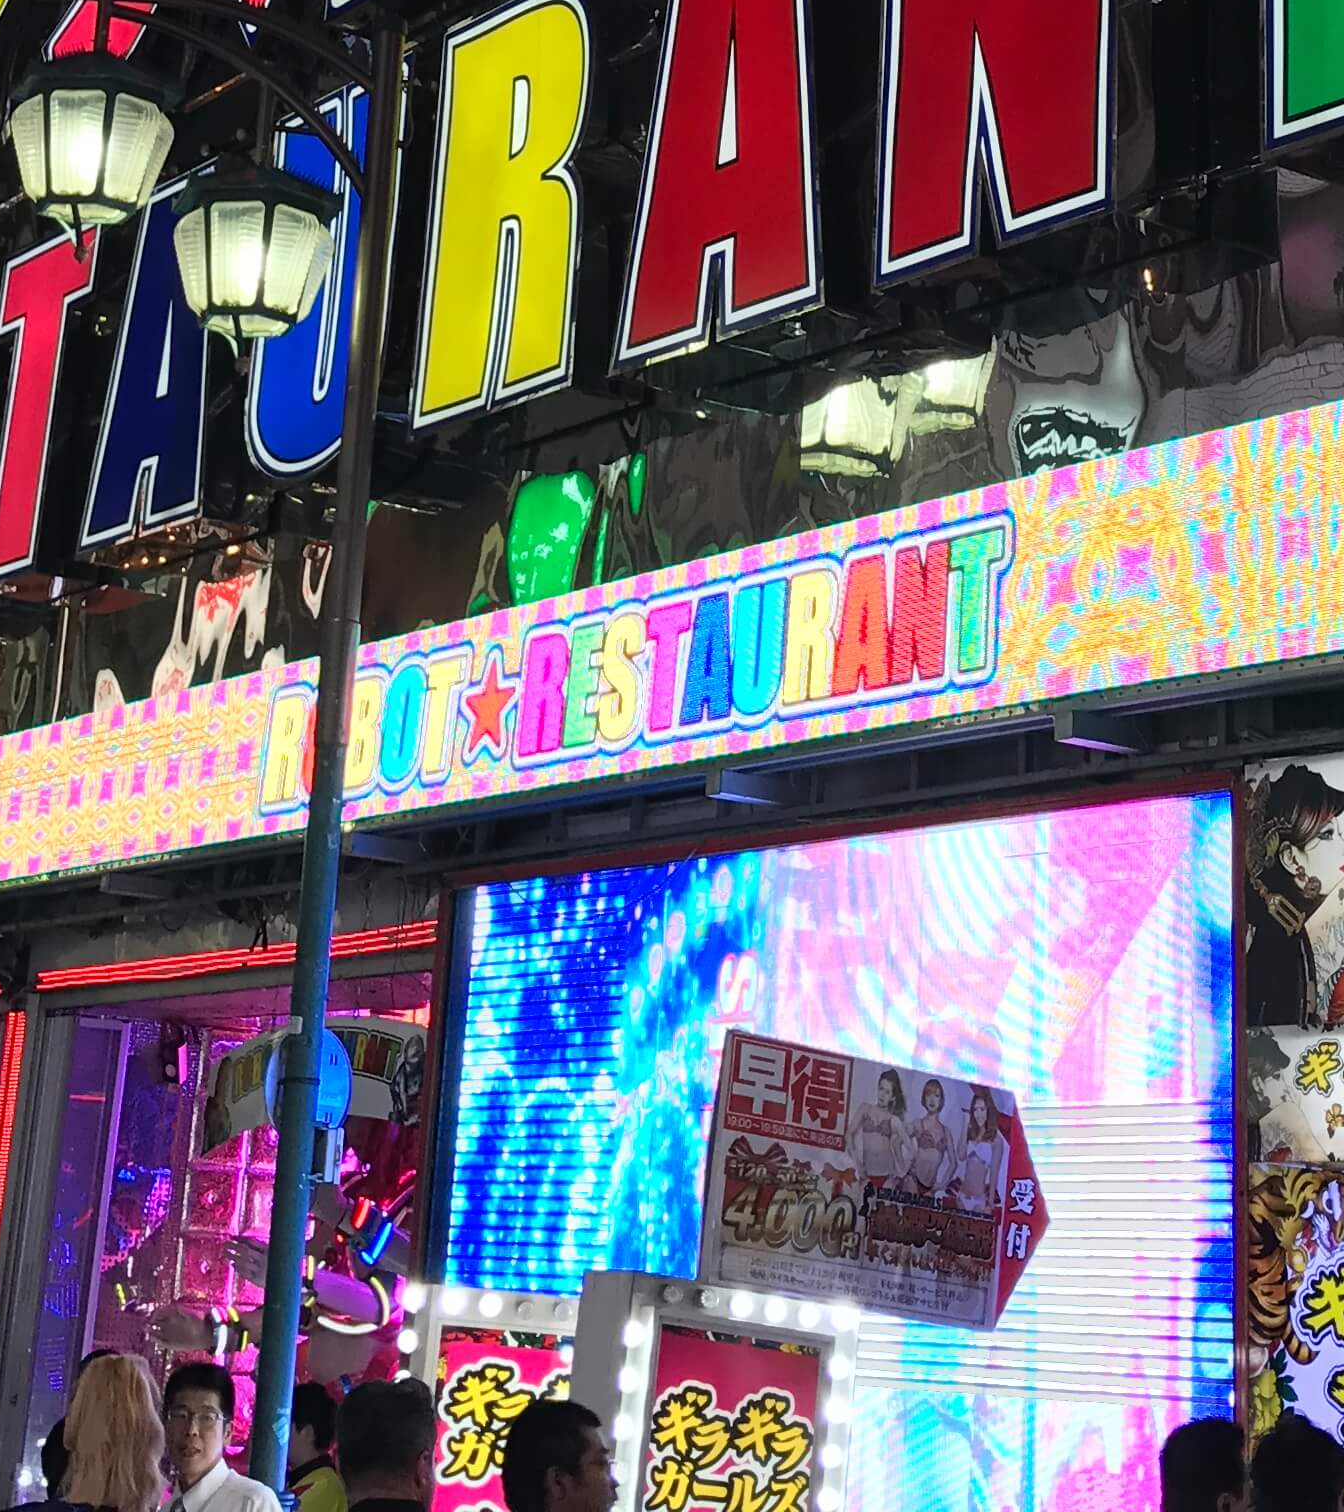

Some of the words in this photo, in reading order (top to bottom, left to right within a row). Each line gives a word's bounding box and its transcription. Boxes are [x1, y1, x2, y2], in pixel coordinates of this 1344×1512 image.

[260, 653, 474, 816] RBOT
[512, 518, 1013, 771] RESTAURANT
[730, 1039, 849, 1136] 早得
[1006, 1177, 1037, 1260] 受付
[654, 1383, 809, 1472] ギラギラ
